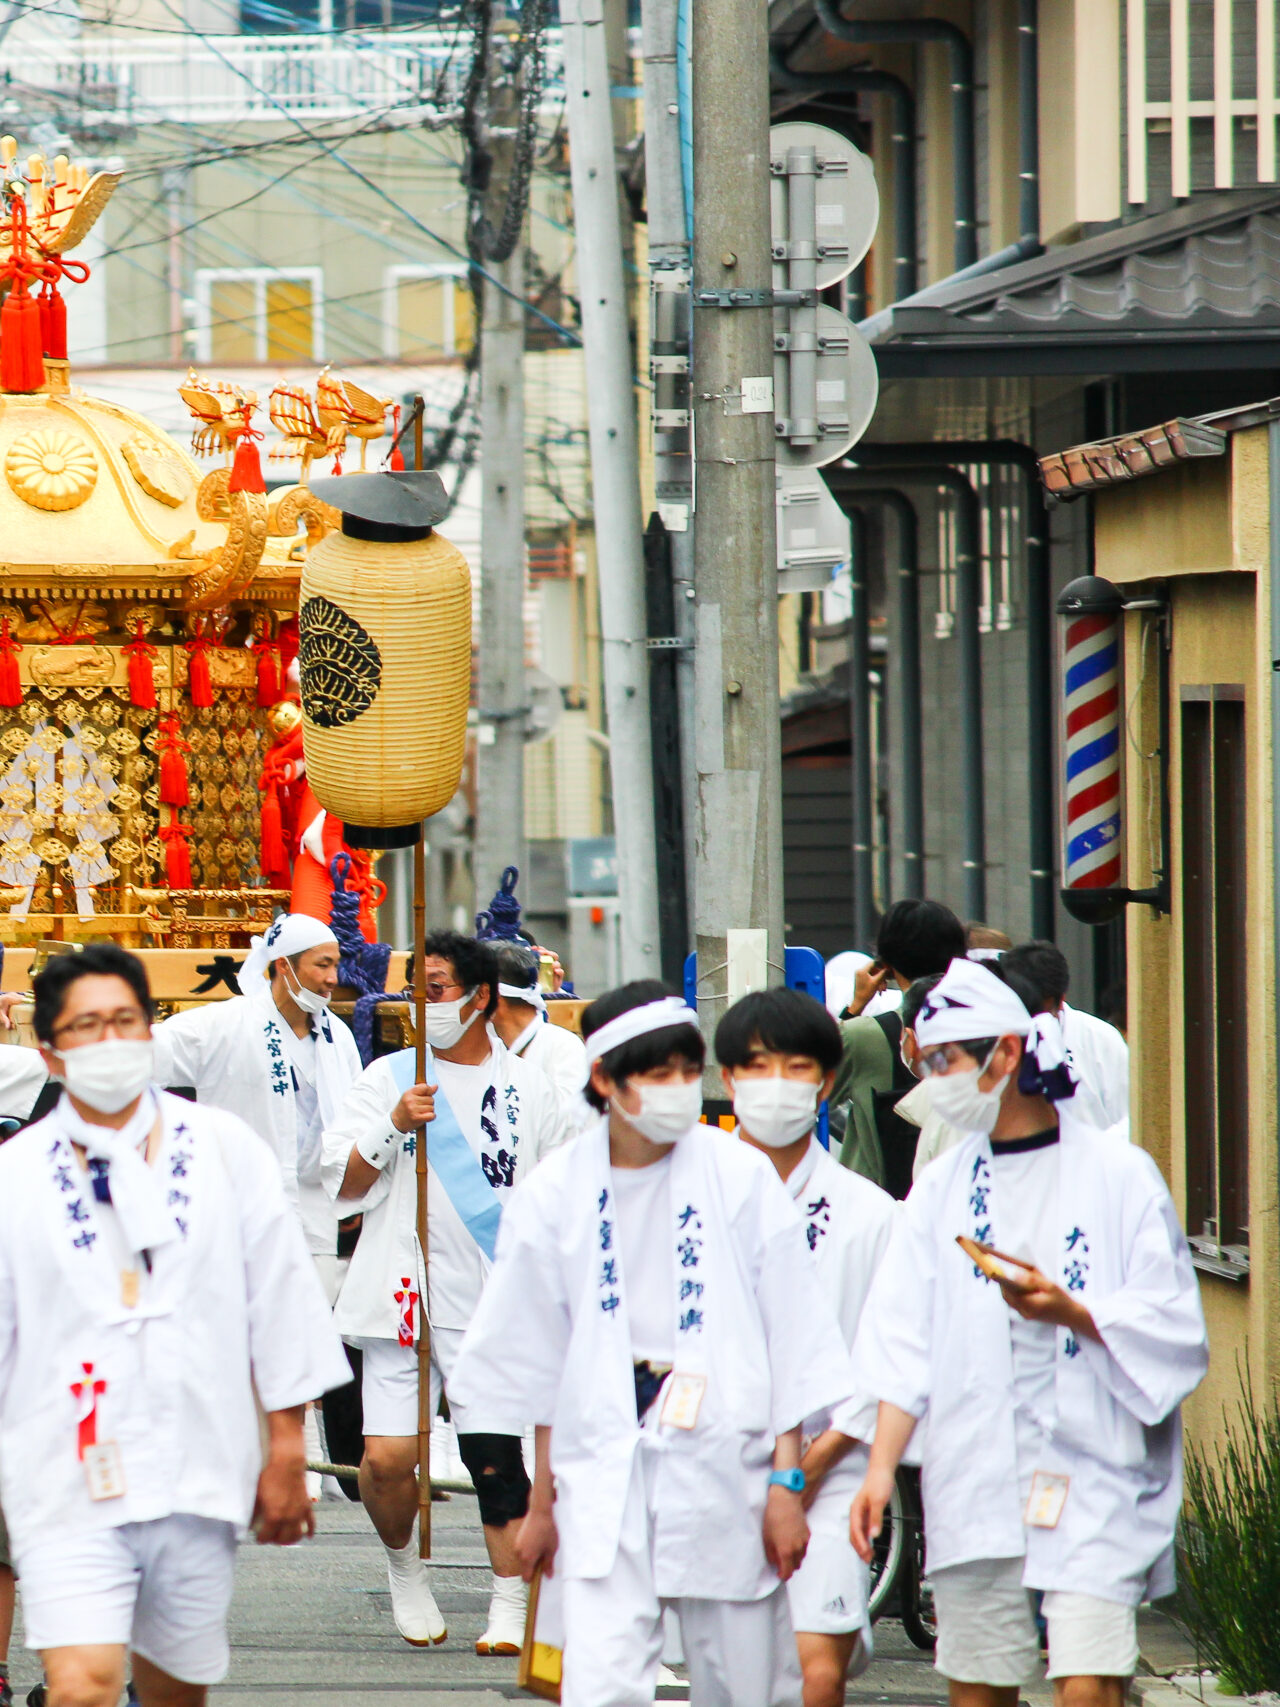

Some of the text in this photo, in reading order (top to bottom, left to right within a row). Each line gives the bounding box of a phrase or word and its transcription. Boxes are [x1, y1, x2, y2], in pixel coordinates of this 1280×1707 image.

[263, 1020, 289, 1096] 大宮若中
[1063, 1226, 1090, 1359] 大宮
